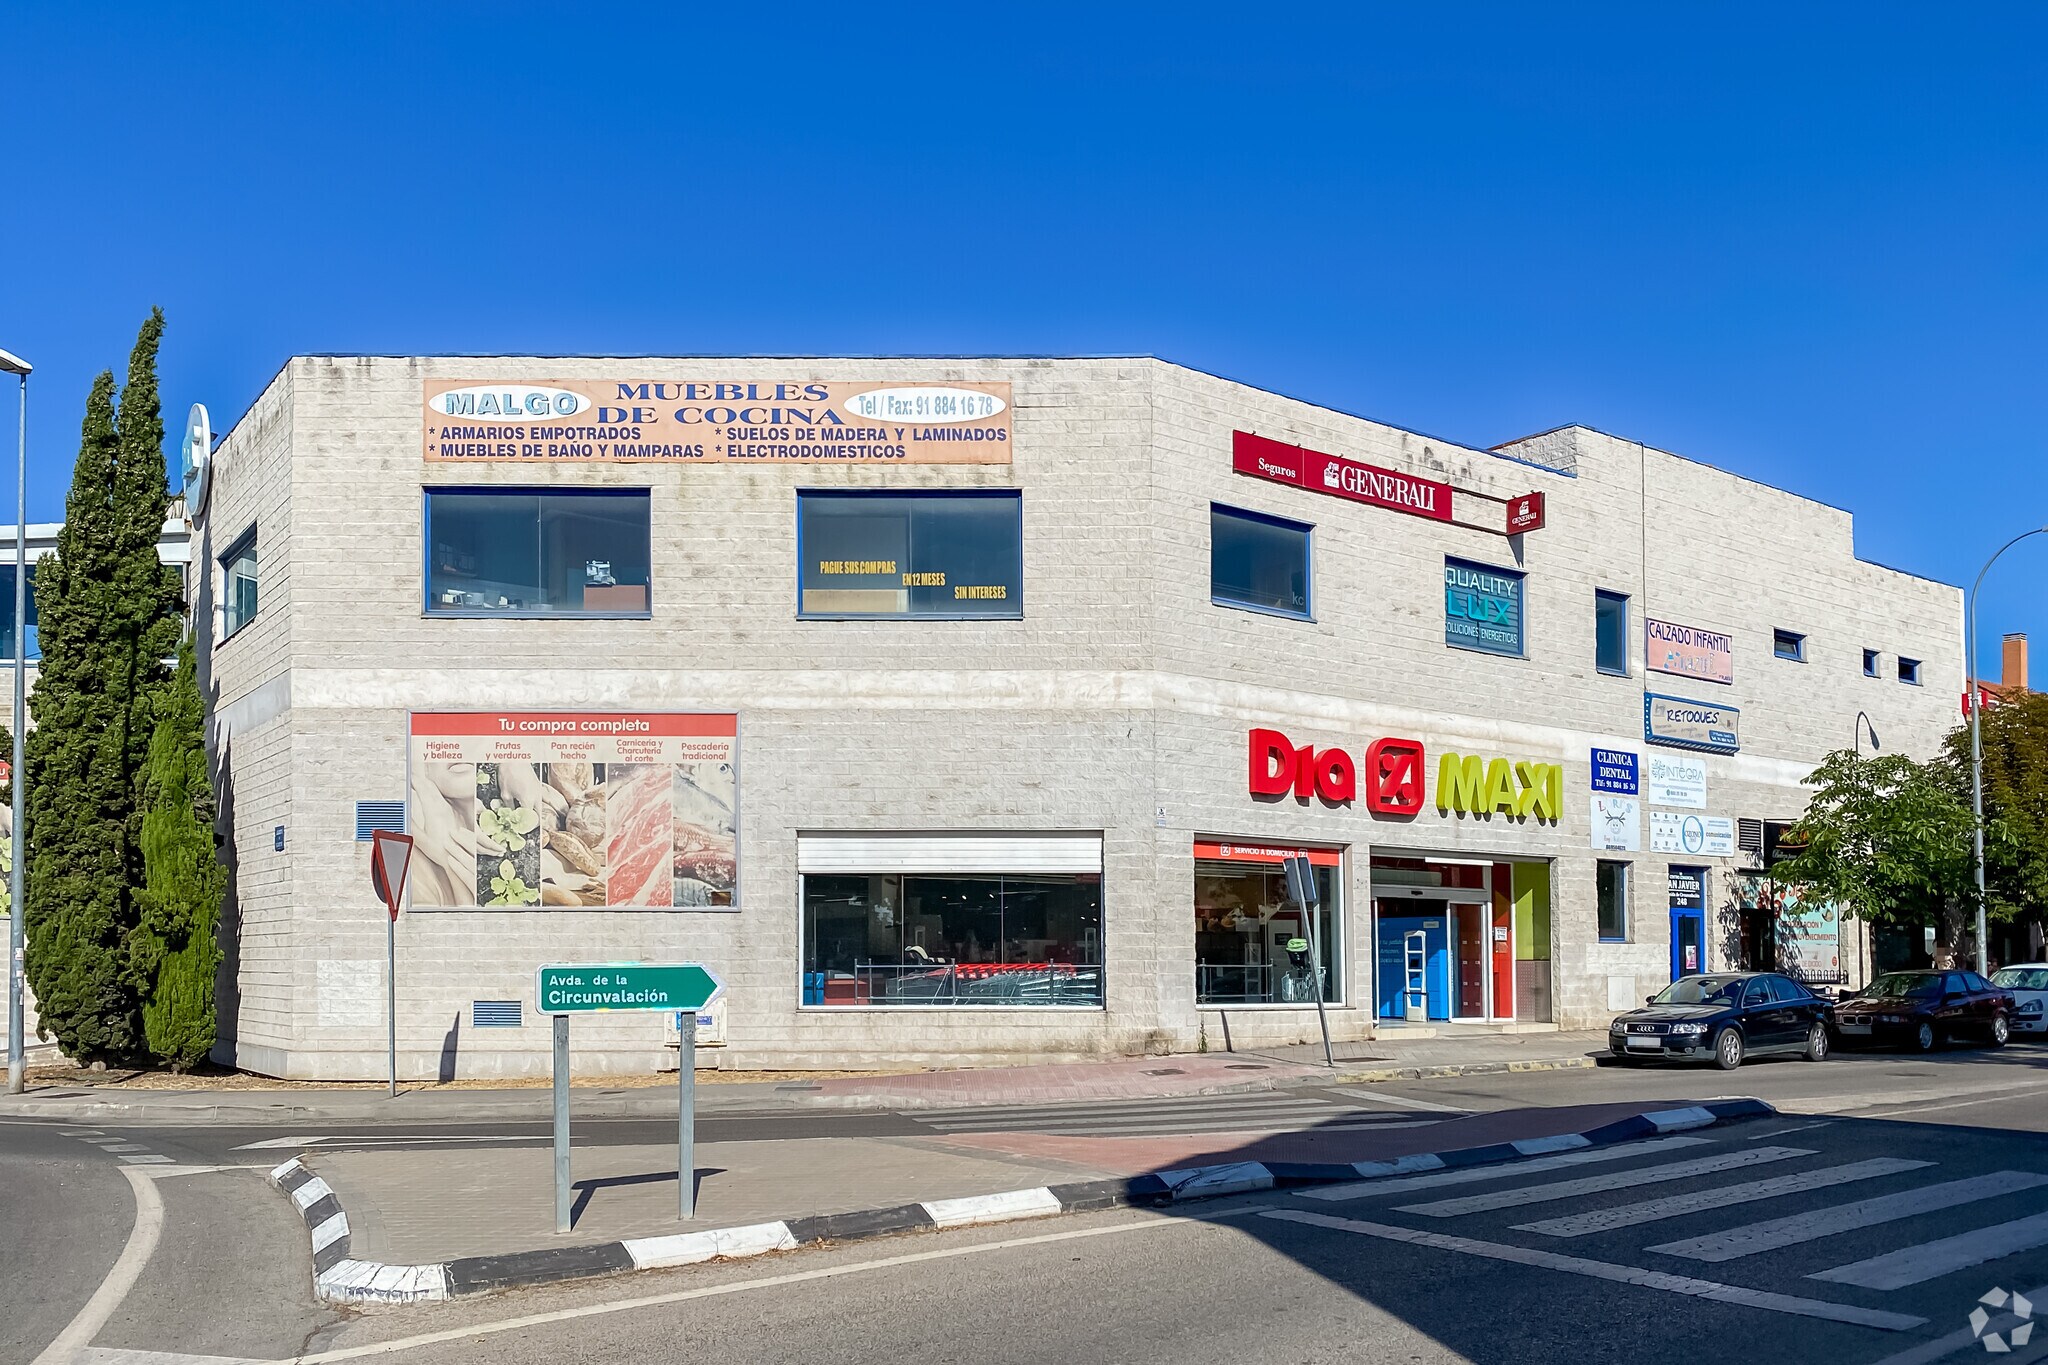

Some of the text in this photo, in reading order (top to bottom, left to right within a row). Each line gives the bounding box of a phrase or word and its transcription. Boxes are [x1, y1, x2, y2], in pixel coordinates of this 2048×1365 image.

[615, 383, 829, 401] MUEBLES
[445, 392, 579, 416] MALGO
[859, 396, 876, 415] Tel
[888, 396, 912, 415] Fax:
[916, 396, 930, 415] 91
[934, 396, 956, 416] 884
[961, 396, 974, 416] 16
[979, 397, 993, 415] 78
[597, 407, 846, 425] DE COCINA
[440, 427, 641, 440] ARMARIOS EMPOTRADOS
[727, 428, 1007, 442] SUELOS DE MADERA Y LAMINADOS
[440, 440, 704, 458] MUEBLES DE BAÑO Y MAMPARAS
[727, 445, 906, 458] ELECTRODOMESTICOS
[1257, 456, 1297, 479] Seguros
[1341, 465, 1436, 512] GENERALI
[1511, 511, 1537, 525] GENERALI
[820, 561, 896, 574] PAGUE SUS COMPRAS
[902, 573, 946, 586] EN 12 MESES
[1445, 567, 1514, 596] QUALITY
[954, 586, 1006, 599] SIN INTERESES
[1447, 590, 1511, 625] LUX
[1649, 621, 1731, 654] CALZADO INFANTIL
[1667, 709, 1720, 724] RETOQUES
[498, 718, 650, 734] Tu compra completa
[426, 741, 460, 751] Higiene
[495, 741, 521, 750] Frutas
[551, 741, 595, 750] Pan recién
[616, 738, 664, 748] Carnicería y
[681, 742, 729, 751] Pescadería
[431, 751, 462, 759] belleza
[485, 751, 531, 761] y verduras
[561, 751, 587, 759] hecho
[617, 747, 661, 755] Charcutería
[682, 751, 727, 760] tradicional
[1597, 751, 1633, 766] CLINICA
[1599, 766, 1631, 780] DENTAL
[1436, 752, 1563, 819] MAXI
[1234, 846, 1259, 855] SERVICIO
[1266, 848, 1295, 857] DOMICILIO
[1668, 880, 1700, 890] AN JAVIER
[549, 975, 628, 986] Avda. de la
[549, 989, 668, 1004] Circunvalación
